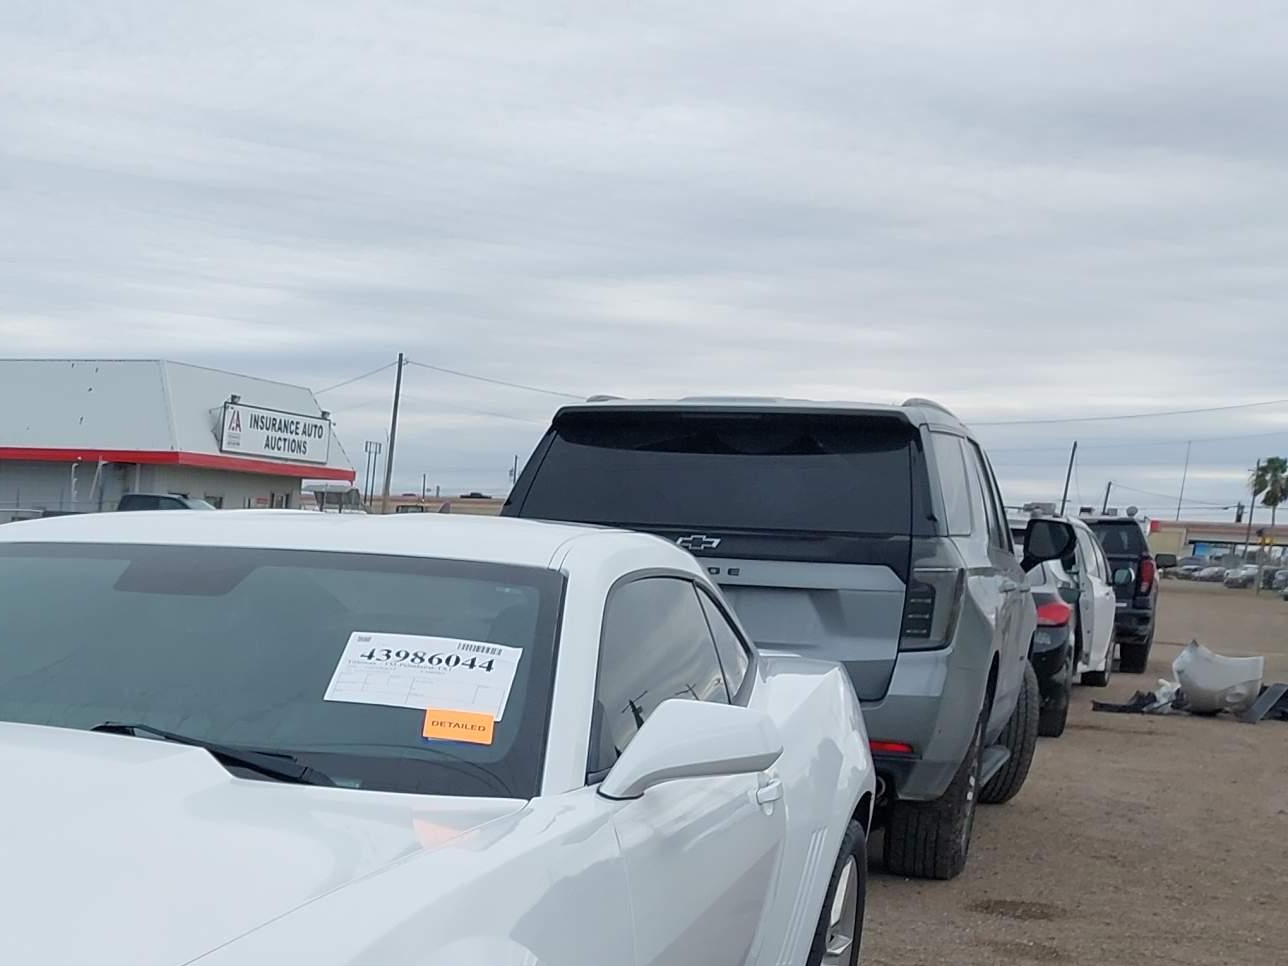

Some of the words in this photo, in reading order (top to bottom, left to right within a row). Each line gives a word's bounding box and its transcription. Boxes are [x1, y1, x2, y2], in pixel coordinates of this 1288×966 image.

[249, 413, 301, 436] INSURANCE
[301, 423, 324, 440] AUTO
[264, 435, 307, 455] AUCTIONS
[360, 648, 494, 672] 43986044
[431, 720, 486, 732] DETAILED
